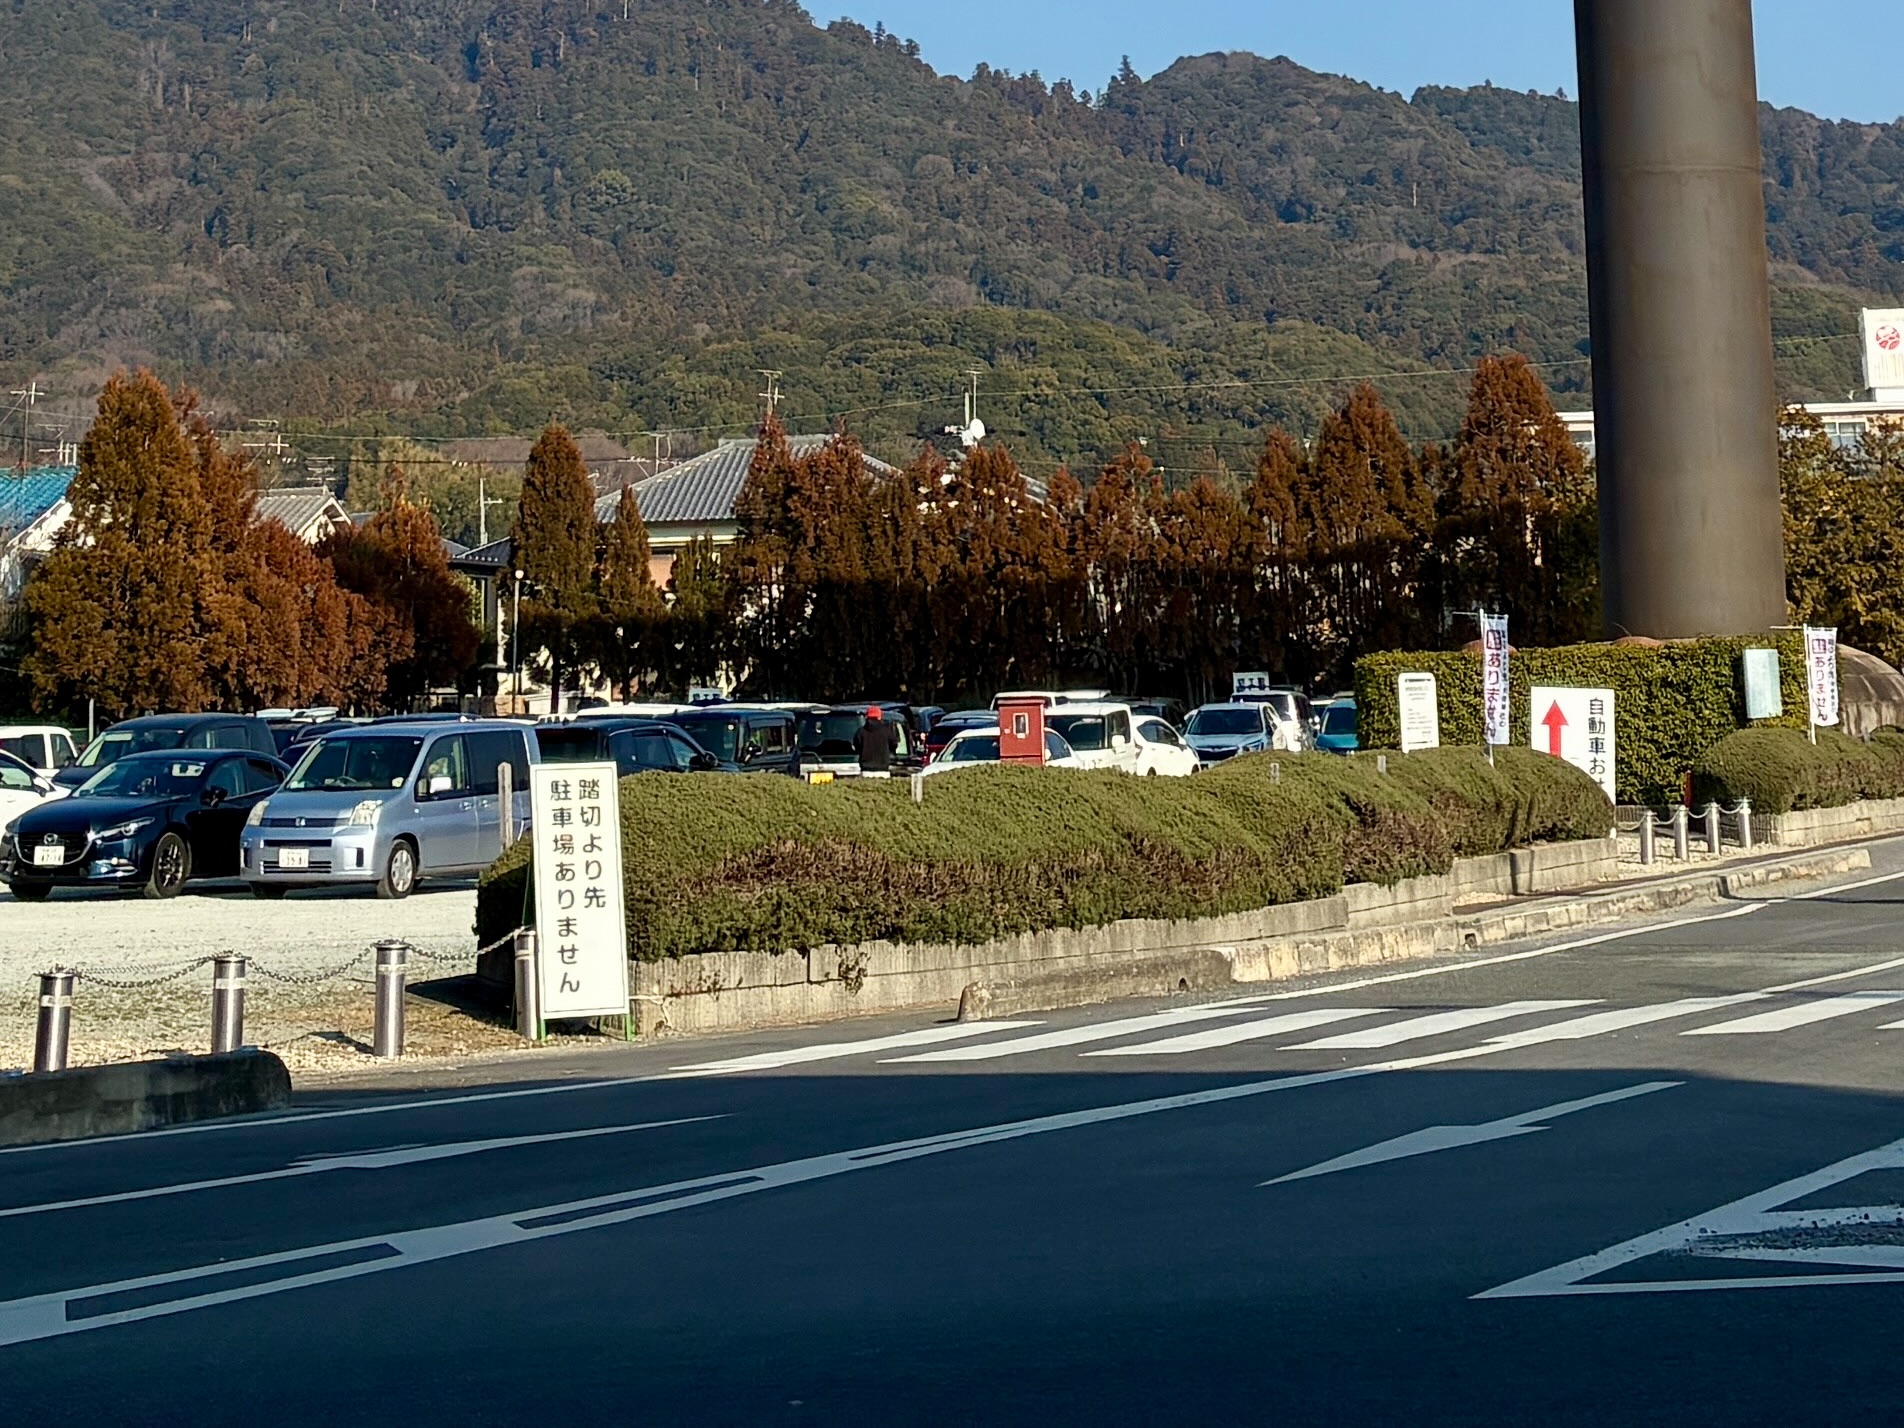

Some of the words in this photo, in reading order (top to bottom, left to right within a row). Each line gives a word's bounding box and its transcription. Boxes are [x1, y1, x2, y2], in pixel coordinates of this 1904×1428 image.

[550, 780, 580, 994] 駐車場ありません
[578, 779, 606, 909] 踏切より先
